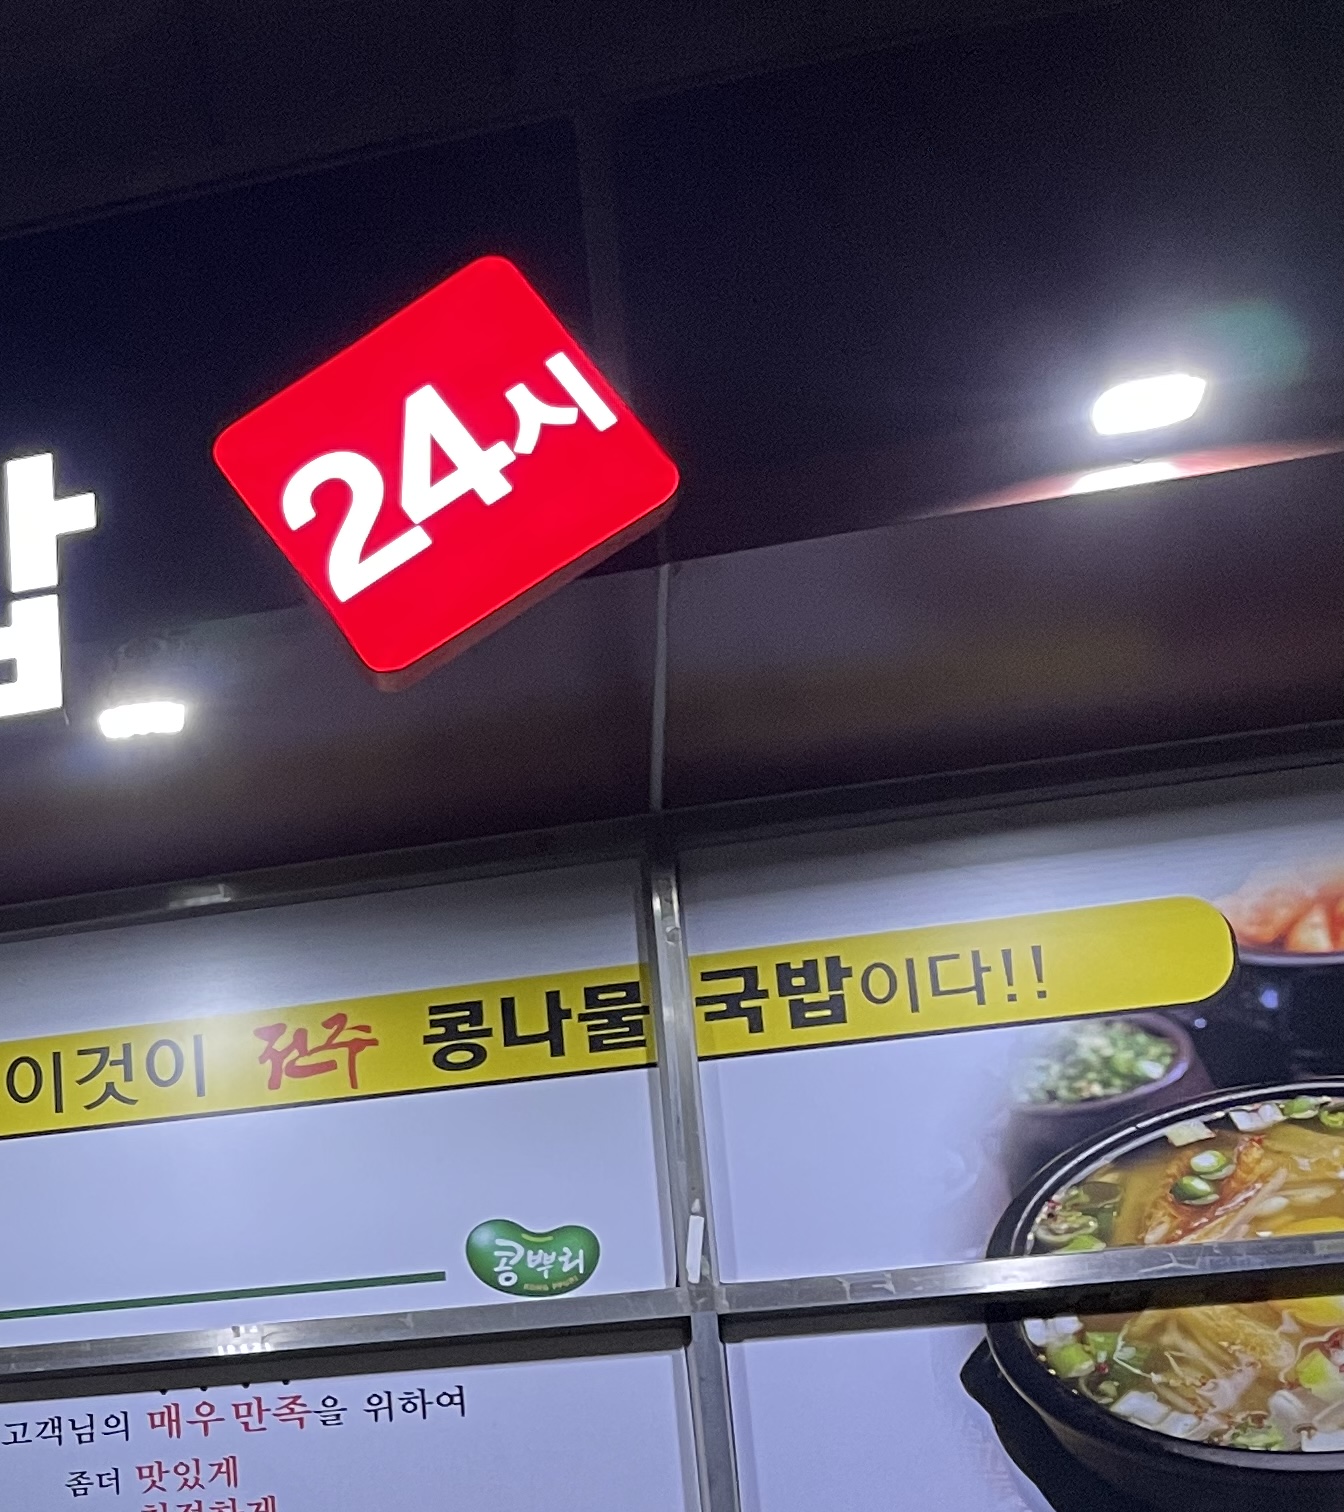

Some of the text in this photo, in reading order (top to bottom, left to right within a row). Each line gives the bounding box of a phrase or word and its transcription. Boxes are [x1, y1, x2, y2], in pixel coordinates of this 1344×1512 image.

[279, 352, 618, 602] 24시
[5, 1035, 207, 1114] 이것이
[256, 1013, 379, 1093] 전주
[493, 1238, 585, 1287] 콩뿌리
[1, 1384, 468, 1448] 고객님의 매우 만족을 위하여
[65, 1455, 240, 1498] 좀더 맛있게
